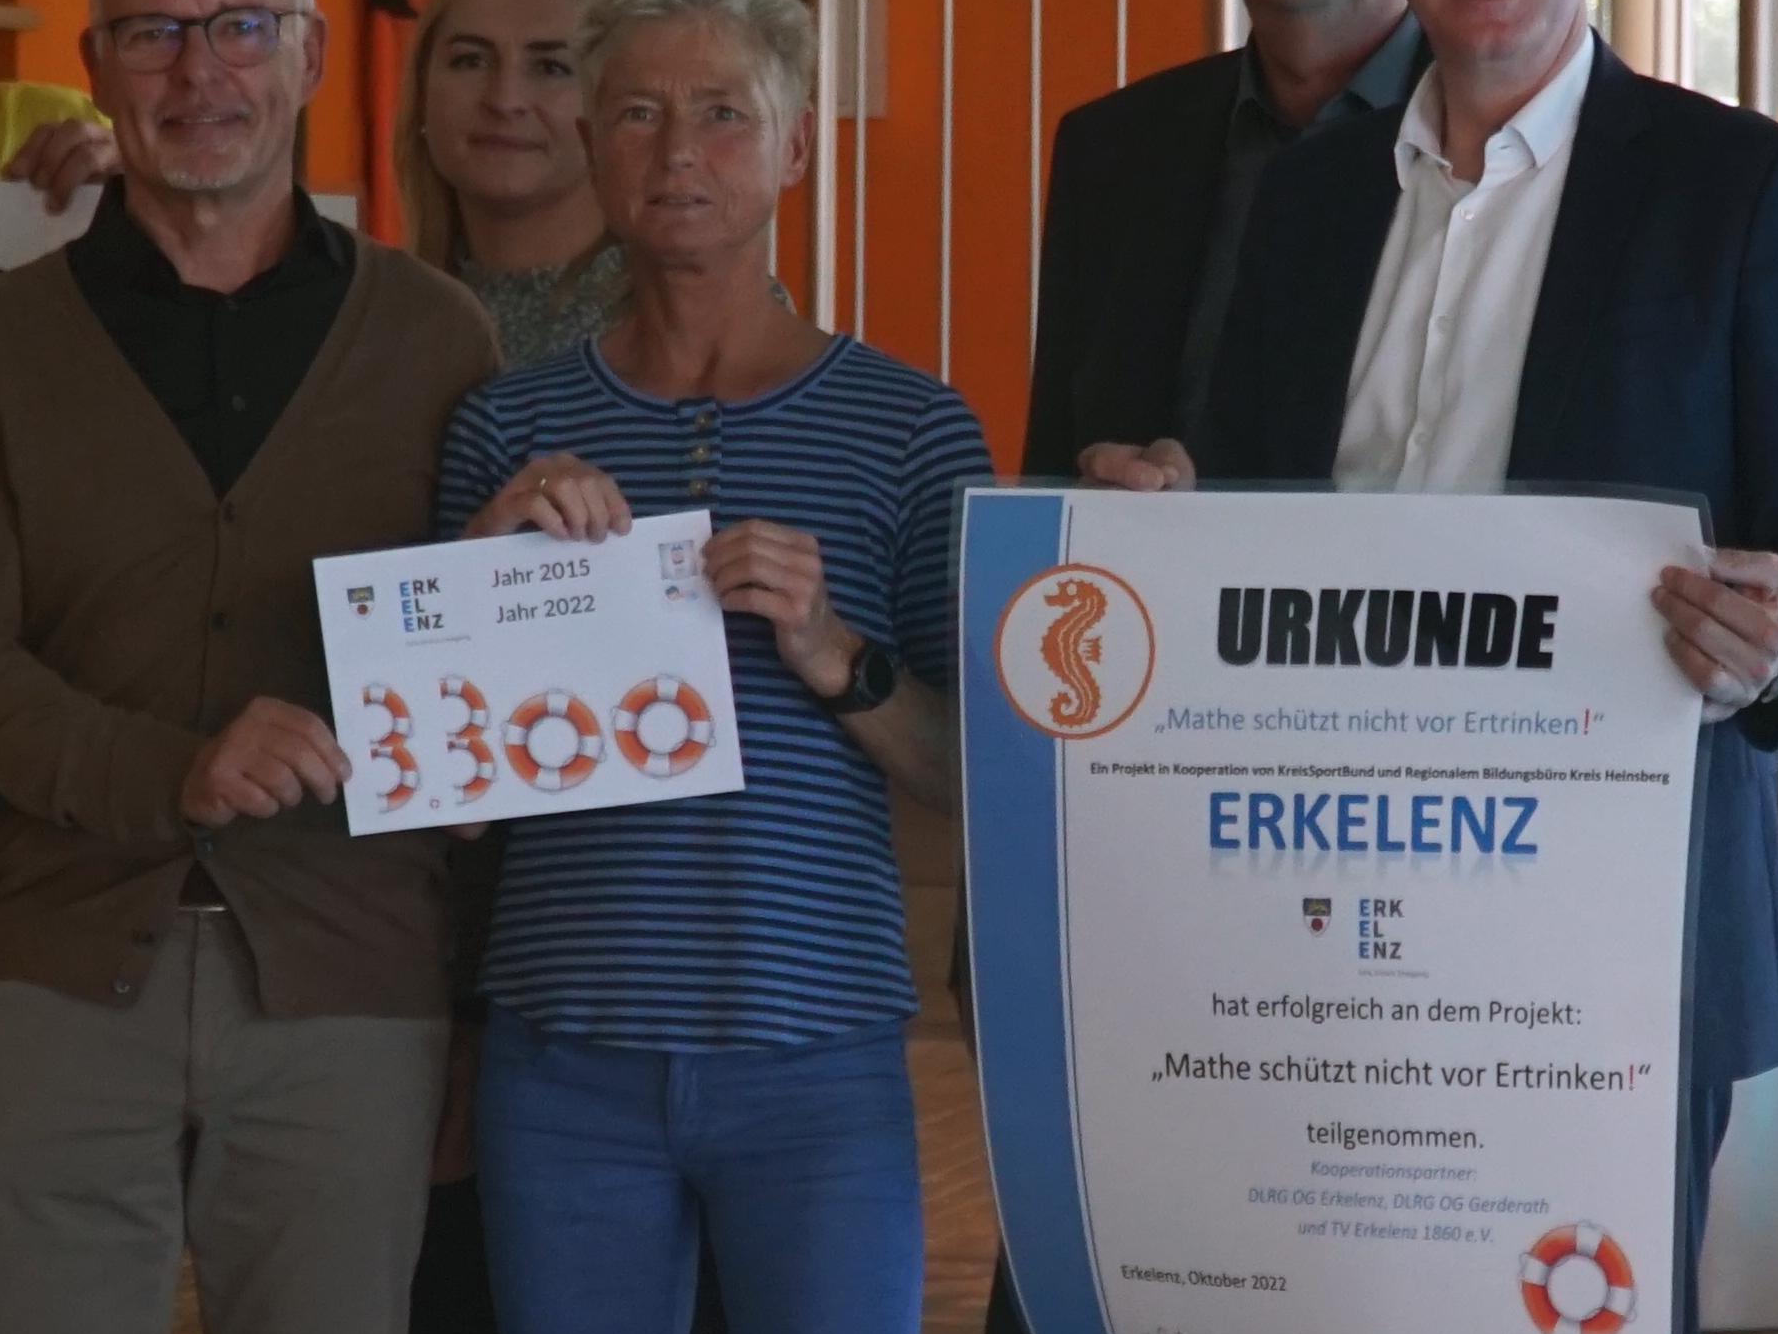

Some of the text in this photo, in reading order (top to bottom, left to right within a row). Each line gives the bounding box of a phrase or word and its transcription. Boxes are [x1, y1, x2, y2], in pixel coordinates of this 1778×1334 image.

[492, 559, 591, 588] Jahr 2015
[399, 577, 441, 598] ERK
[401, 598, 426, 616] EL
[496, 594, 596, 624] Jahr 2022
[404, 613, 445, 633] ENZ
[1216, 587, 1559, 670] URKUNDE
[1253, 708, 1339, 733] schützt
[1348, 709, 1408, 733] nicht
[1417, 716, 1454, 734] vor
[1090, 763, 1670, 786] Ein Projekt in Kooperation von KreisSportBund und Regionalem Bildungsbüro Kreis Heinsberg
[1209, 791, 1539, 855] ERKELENZ
[1359, 898, 1405, 918] ERK
[1359, 920, 1385, 939] EL
[1359, 941, 1403, 960] ENZ
[1212, 993, 1582, 1030] hat erfolgreich an dem Projekt:
[1259, 1055, 1357, 1086] schützt
[1364, 1059, 1434, 1086] nicht
[1441, 1069, 1487, 1088] vor
[1306, 1120, 1484, 1151] teilgenommen.
[1248, 1188, 1288, 1205] DLRG
[1293, 1188, 1316, 1205] OG
[1393, 1193, 1433, 1210] DLRG
[1439, 1195, 1463, 1212] OG
[1469, 1197, 1550, 1214] Gerderath
[1298, 1220, 1325, 1236] und
[1331, 1222, 1351, 1237] TV
[1355, 1223, 1418, 1240] Erkelenz
[1423, 1226, 1461, 1241] 1860
[1121, 1264, 1287, 1293] Erkelenz, Oktober 2022
